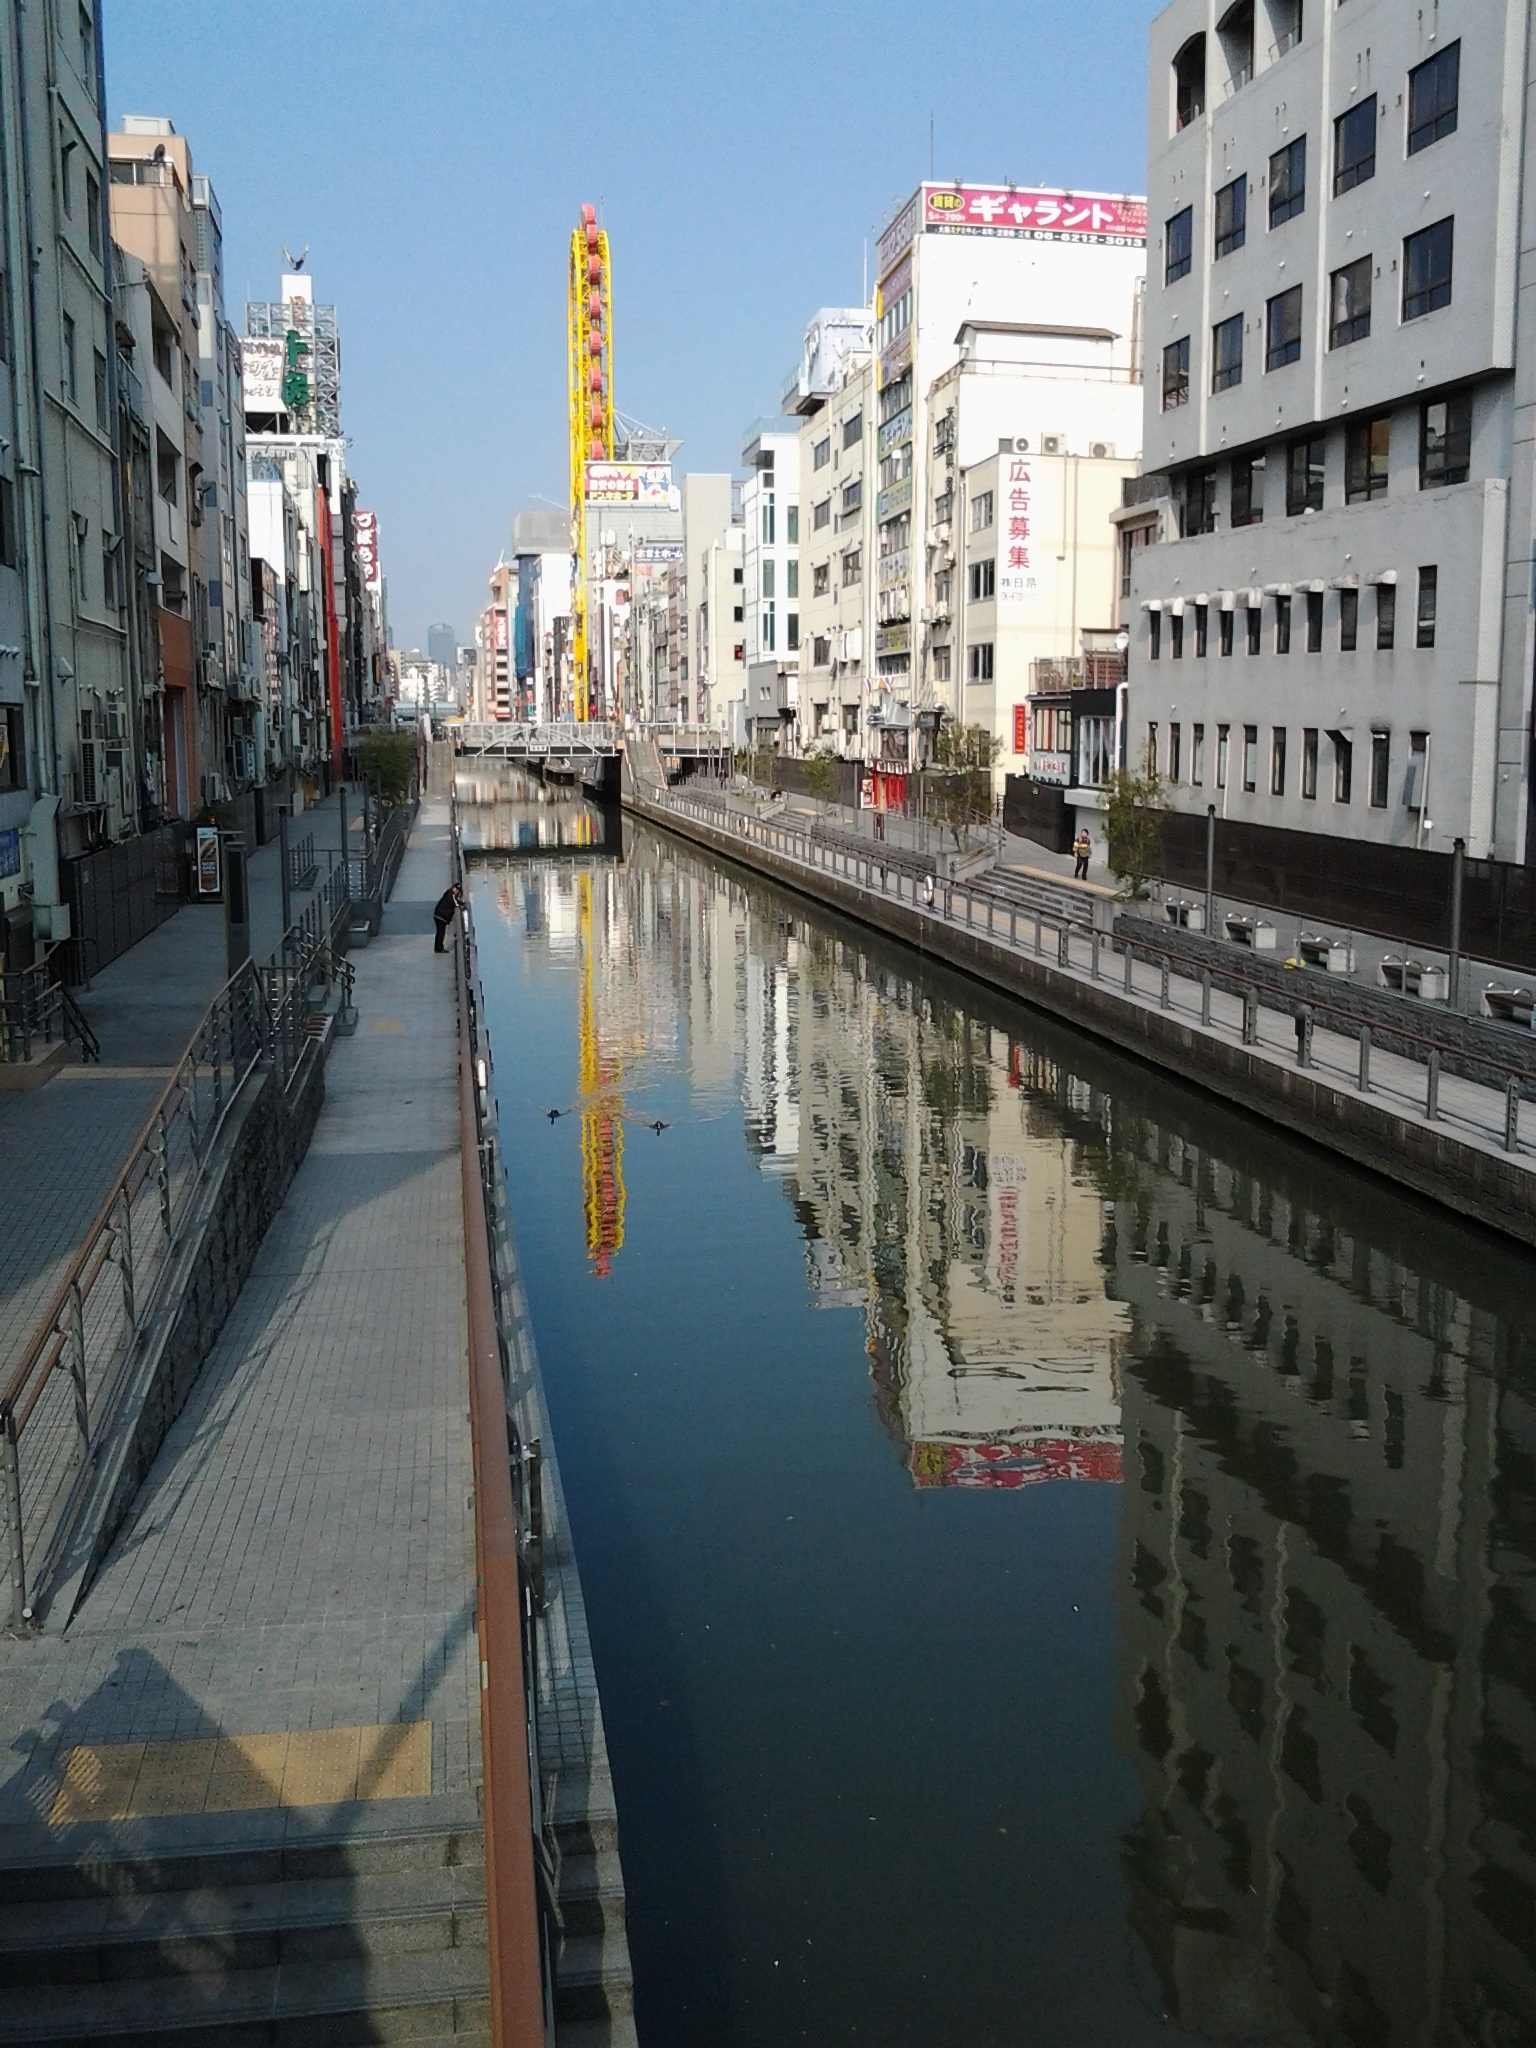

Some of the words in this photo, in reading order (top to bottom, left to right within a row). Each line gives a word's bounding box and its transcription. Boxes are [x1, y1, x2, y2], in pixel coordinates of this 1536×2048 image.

[969, 195, 1114, 230] ギャラント
[1034, 231, 1142, 247] 06-6212-3013
[1007, 459, 1031, 569] 広告募集
